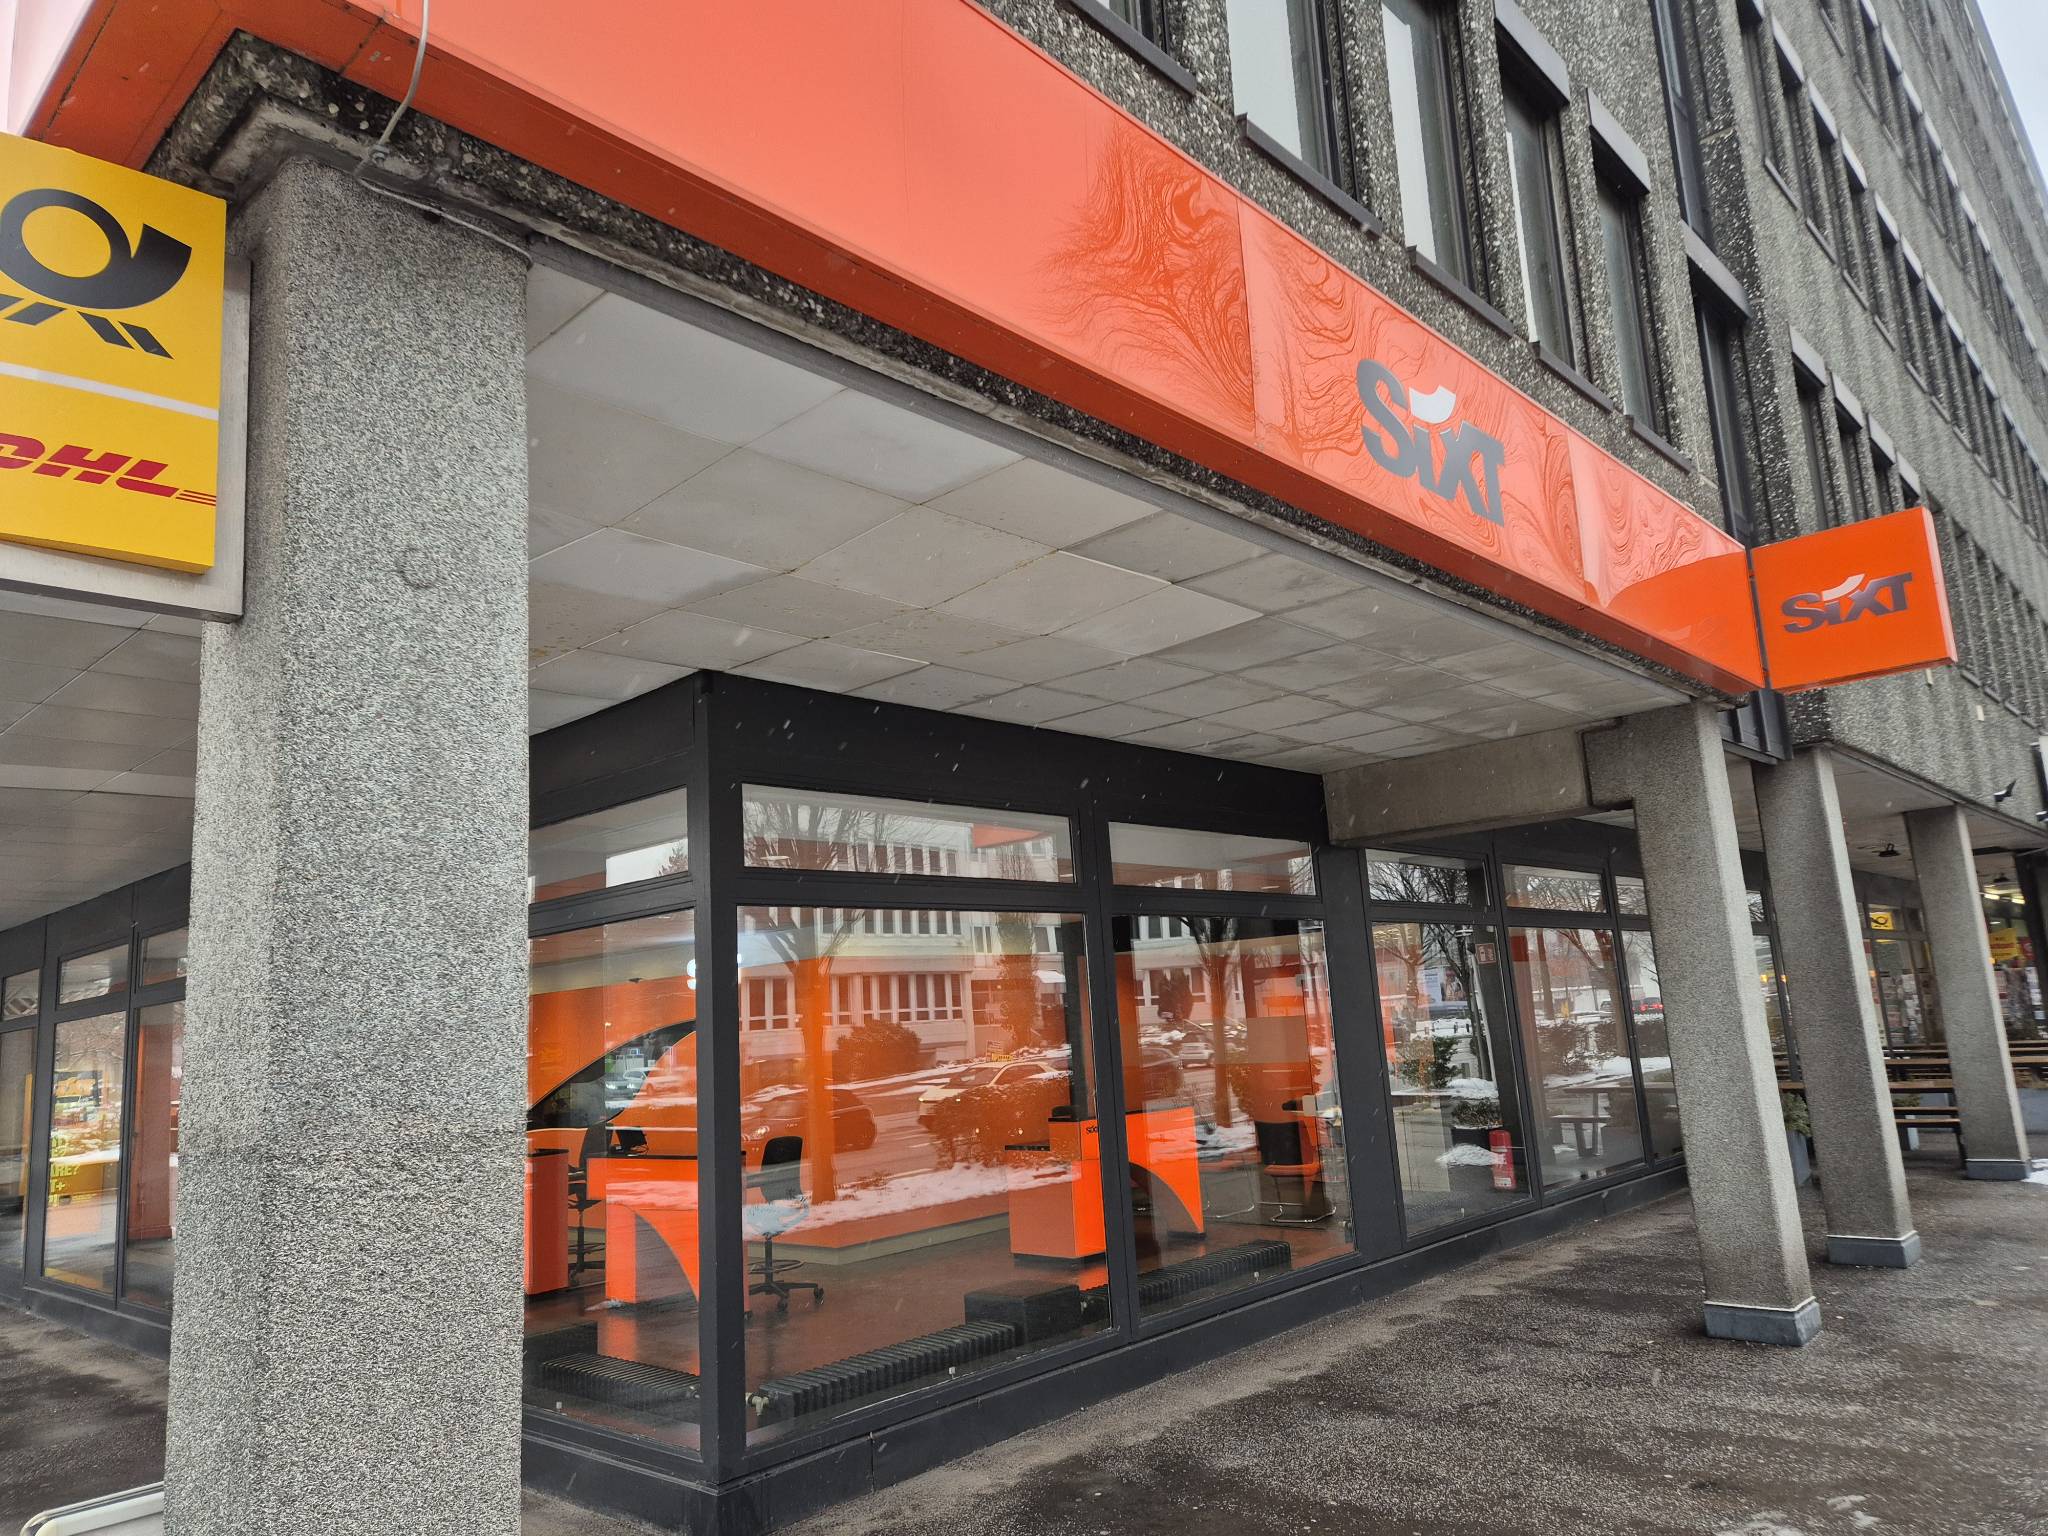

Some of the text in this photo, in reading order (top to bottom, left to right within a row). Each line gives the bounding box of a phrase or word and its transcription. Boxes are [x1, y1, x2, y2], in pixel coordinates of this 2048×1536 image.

[0, 432, 180, 498] DHL
[1356, 358, 1505, 528] SIXT
[1781, 572, 1913, 634] SIXT
